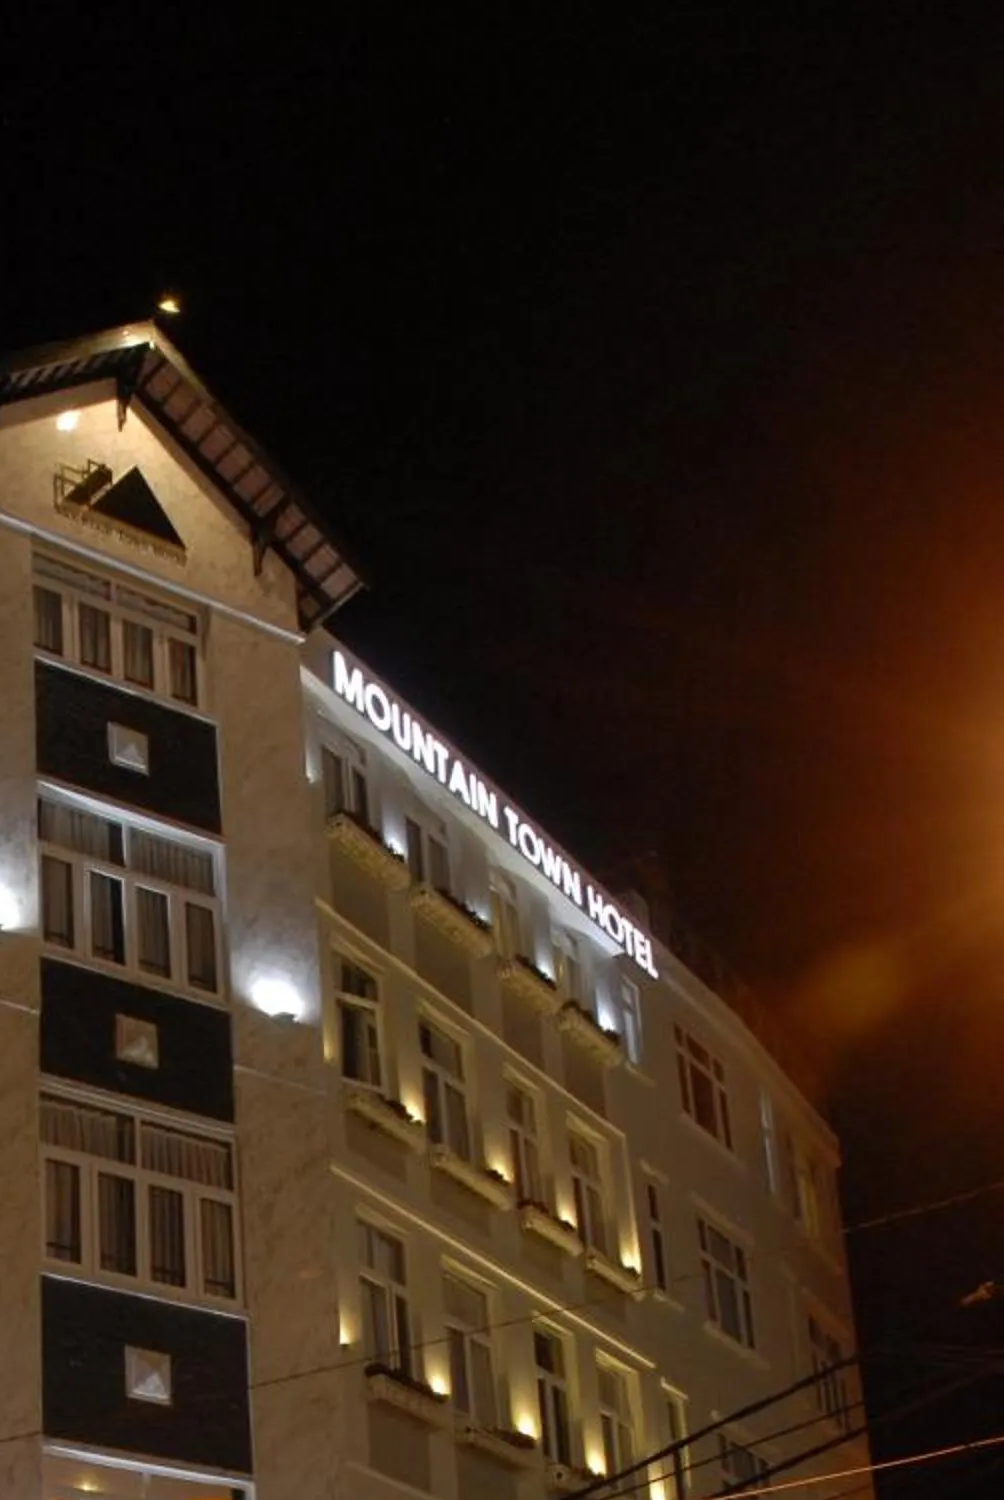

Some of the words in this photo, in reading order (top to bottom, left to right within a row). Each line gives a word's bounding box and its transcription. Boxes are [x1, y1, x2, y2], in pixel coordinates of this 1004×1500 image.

[332, 650, 499, 829] MOUNTAIN
[504, 805, 582, 905] TOWN
[587, 885, 659, 980] HOTEL
